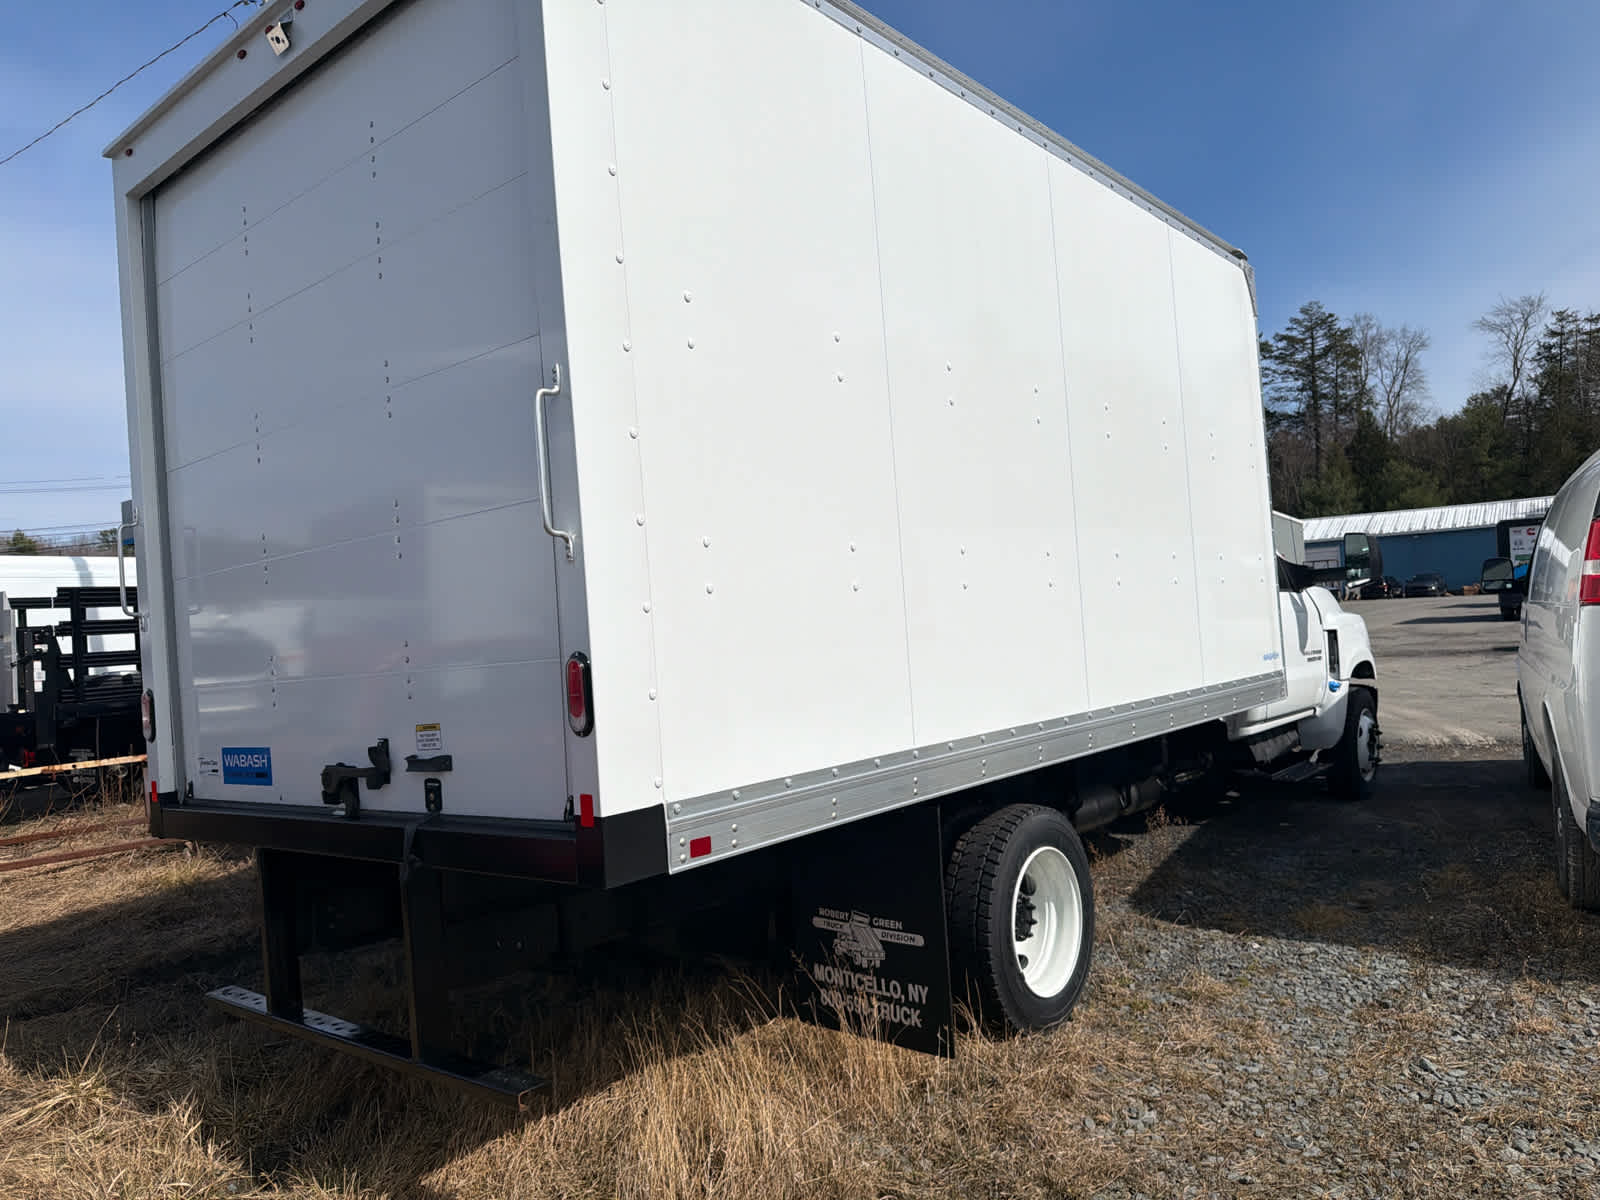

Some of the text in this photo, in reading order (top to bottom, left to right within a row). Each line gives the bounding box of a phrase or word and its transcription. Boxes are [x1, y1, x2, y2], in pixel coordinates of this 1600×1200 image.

[224, 753, 268, 769] WABASH
[872, 917, 903, 930] GREEN
[881, 931, 915, 943] DIVISION
[814, 963, 929, 1005] MONTICELLO, NY
